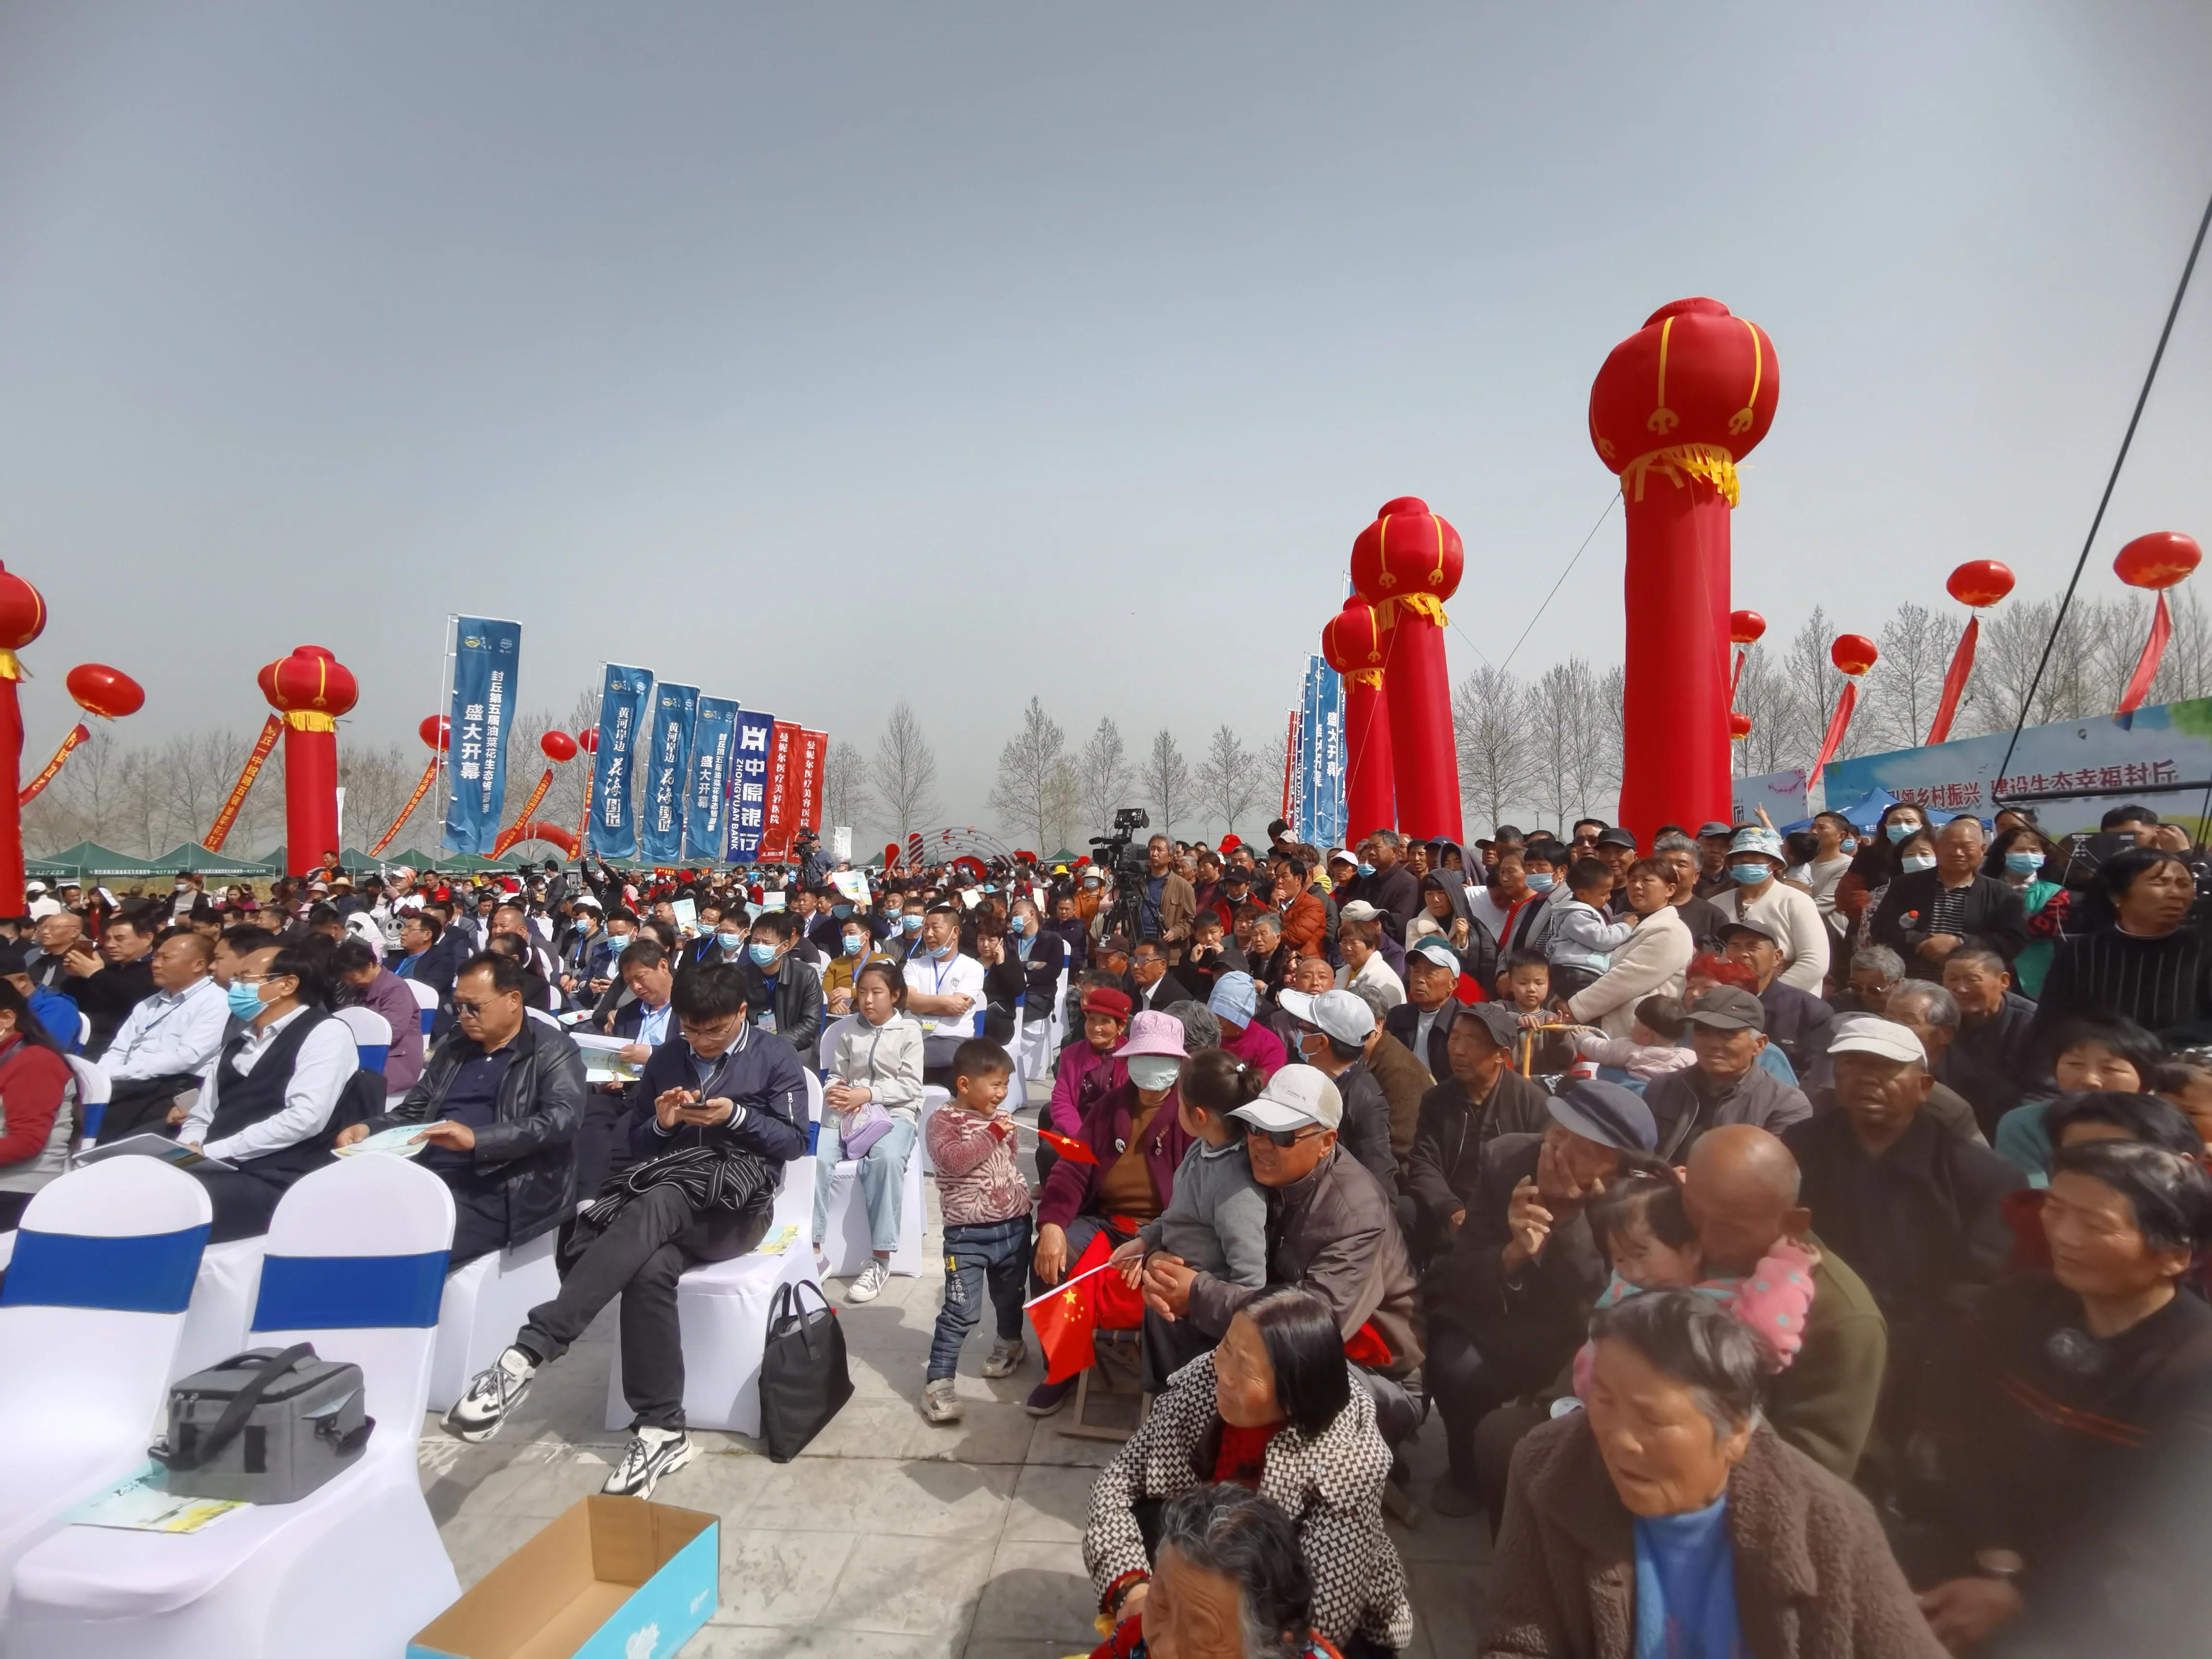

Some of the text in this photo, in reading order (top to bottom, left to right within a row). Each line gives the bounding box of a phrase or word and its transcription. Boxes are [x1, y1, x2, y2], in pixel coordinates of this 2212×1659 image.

[460, 704, 483, 780] 盛大开幕
[613, 707, 630, 752] 黄河岸边
[664, 722, 679, 763] 黄河岸边
[697, 755, 713, 808] 盛大开幕
[731, 759, 744, 850] ZHONGYUAN BANK
[740, 758, 765, 851] 中原银行
[770, 733, 789, 824] 曼妮尔医疗美容医院
[800, 741, 815, 827] 曼妮尔医疗美容医院
